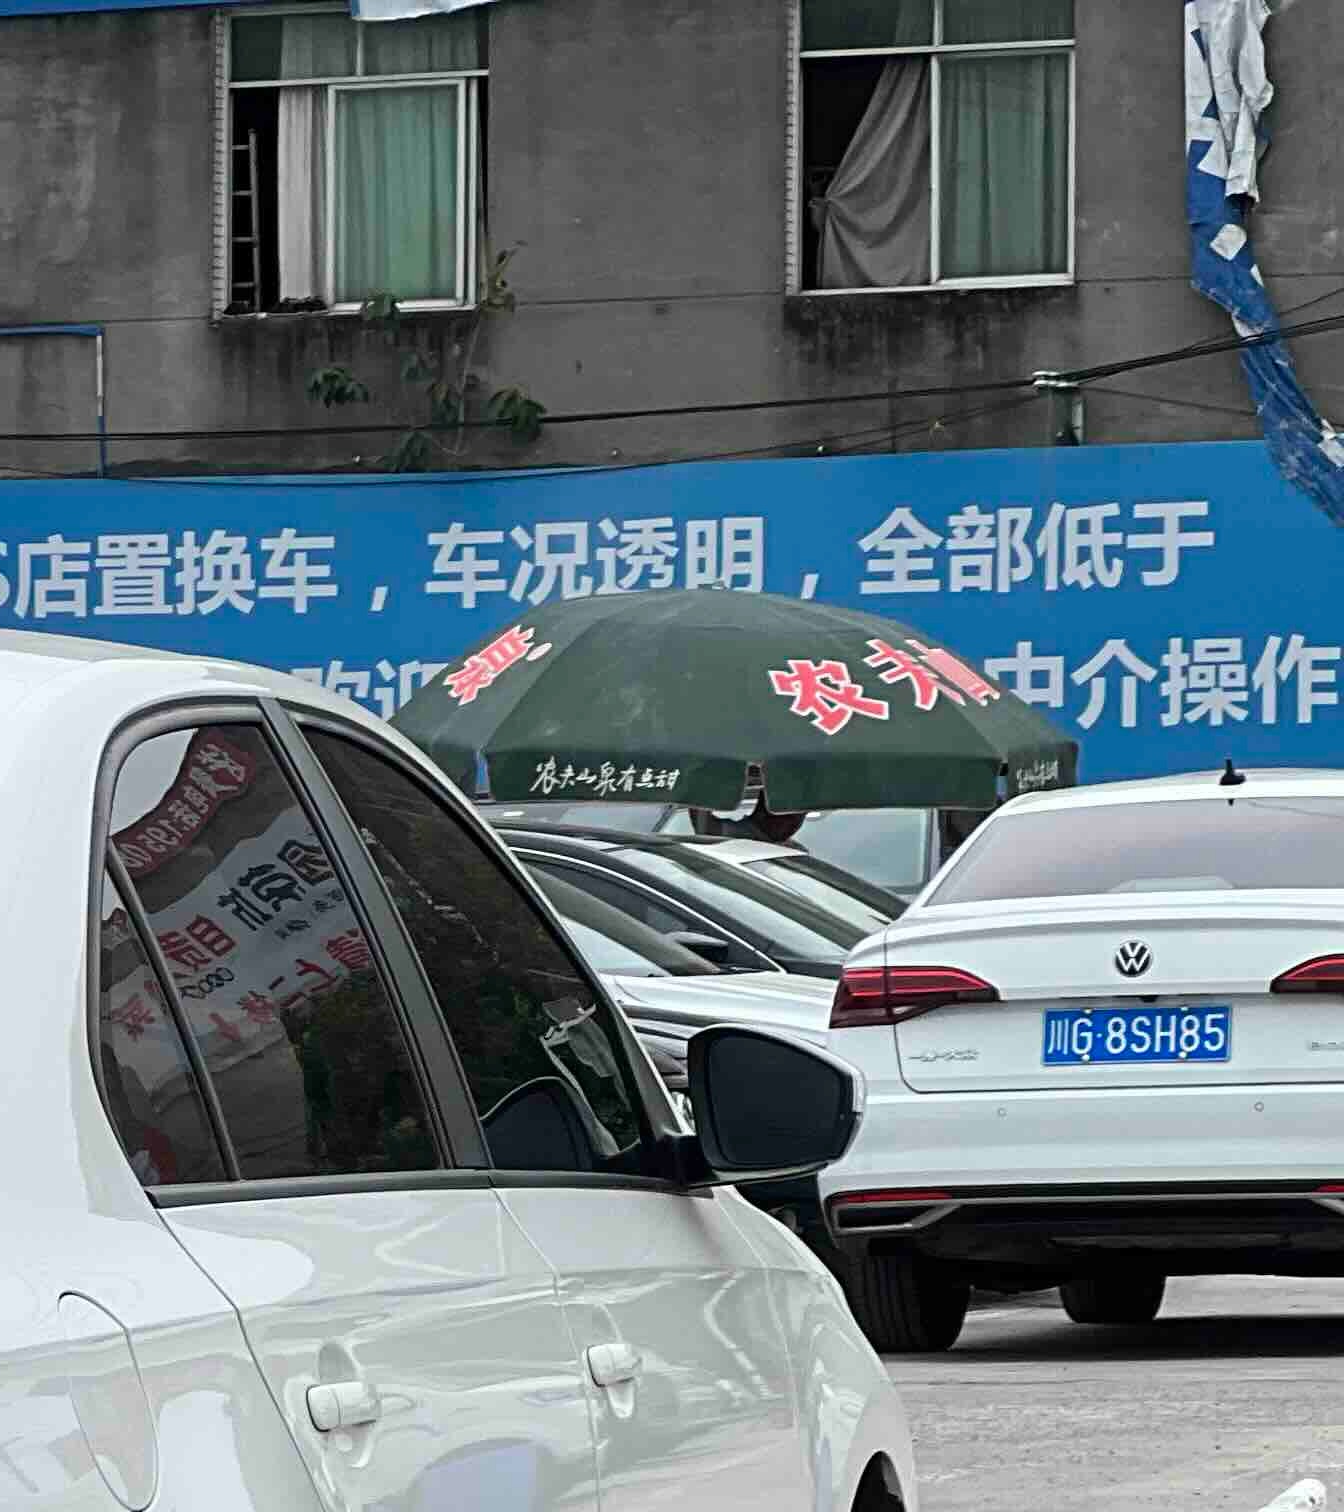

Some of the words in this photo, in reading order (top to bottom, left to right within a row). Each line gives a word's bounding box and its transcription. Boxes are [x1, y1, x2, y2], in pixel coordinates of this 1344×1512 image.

[983, 634, 1342, 729] 中介操作
[529, 755, 681, 797] 农夫山泉有点甜
[1047, 1013, 1226, 1056] 川G·8SH85
